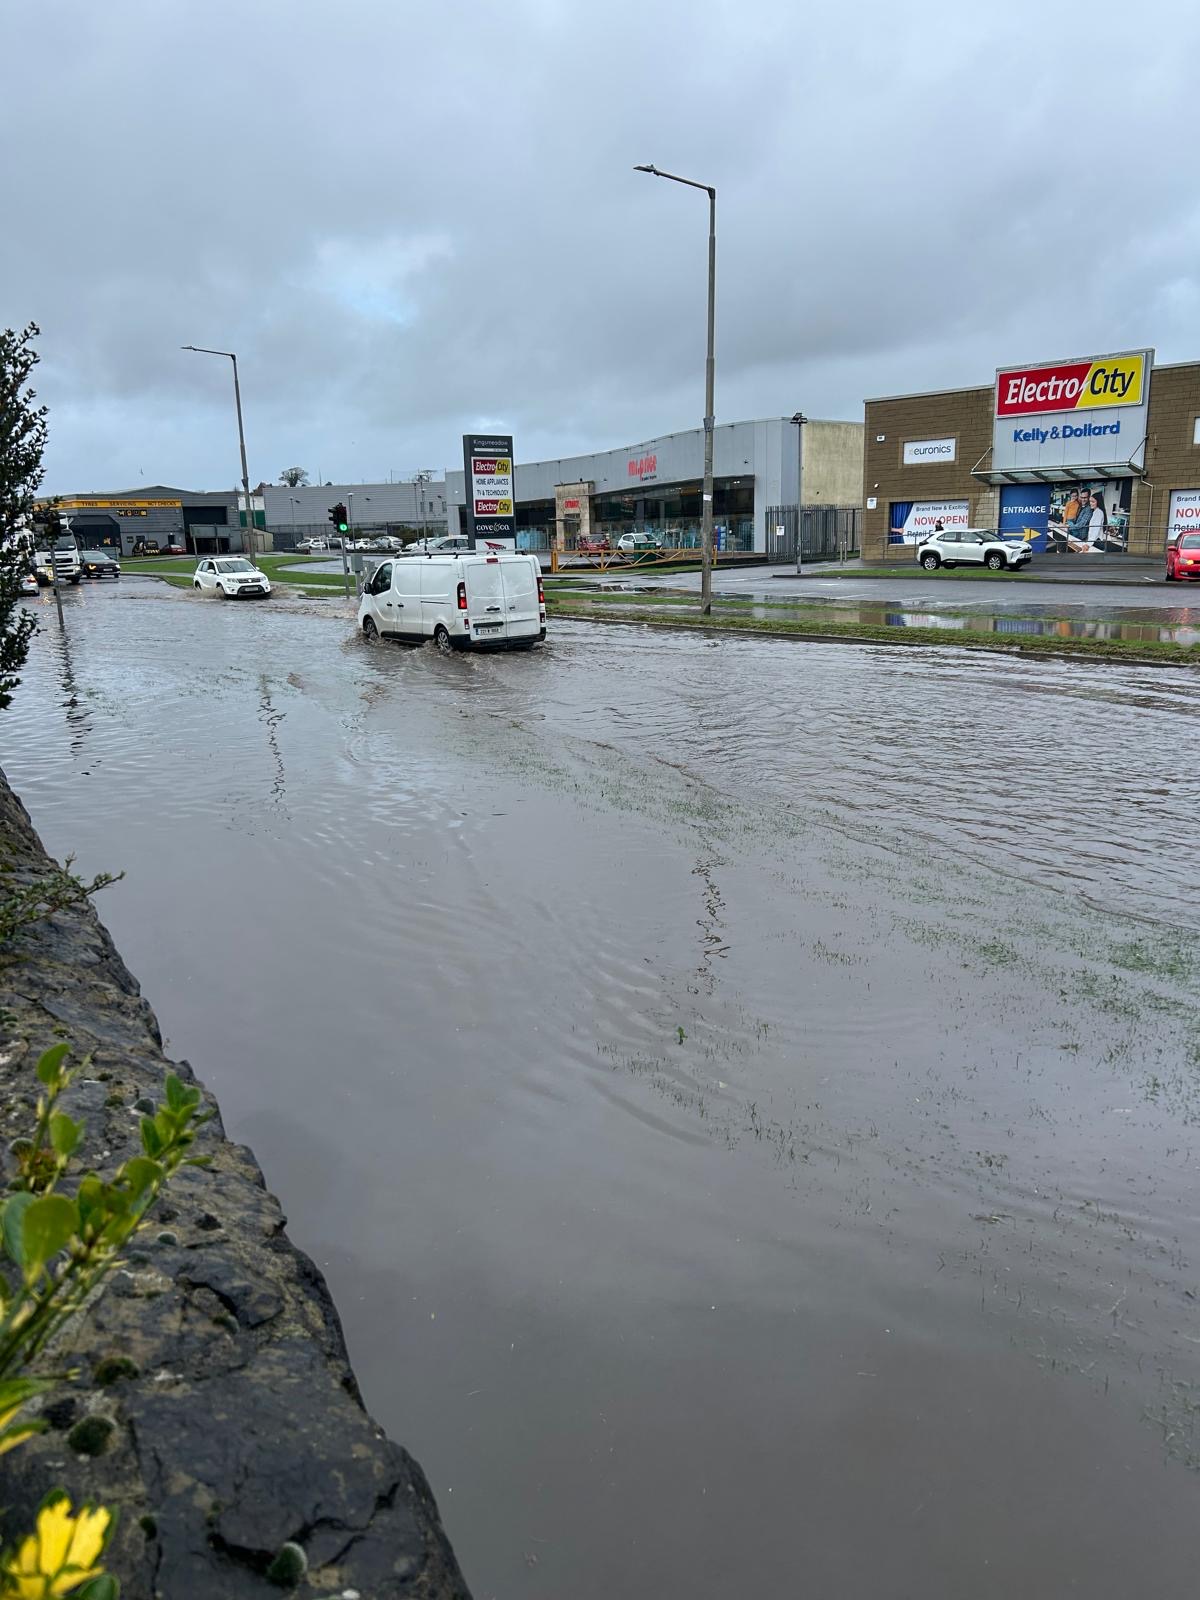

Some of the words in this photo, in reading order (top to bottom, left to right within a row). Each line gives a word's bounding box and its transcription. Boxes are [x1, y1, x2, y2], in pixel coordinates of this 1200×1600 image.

[1004, 375, 1079, 405] Electro
[1090, 368, 1135, 398] City
[1013, 428, 1049, 444] Kelly
[1050, 426, 1059, 439] &
[1062, 421, 1121, 439] Dollard
[913, 445, 951, 456] euronics
[475, 461, 496, 471] Electro
[497, 461, 509, 472] City
[477, 502, 497, 512] Electro
[499, 502, 510, 513] City
[1003, 505, 1046, 514] ENTRANCE
[914, 516, 937, 526] NOW
[939, 515, 968, 525] OPEN!
